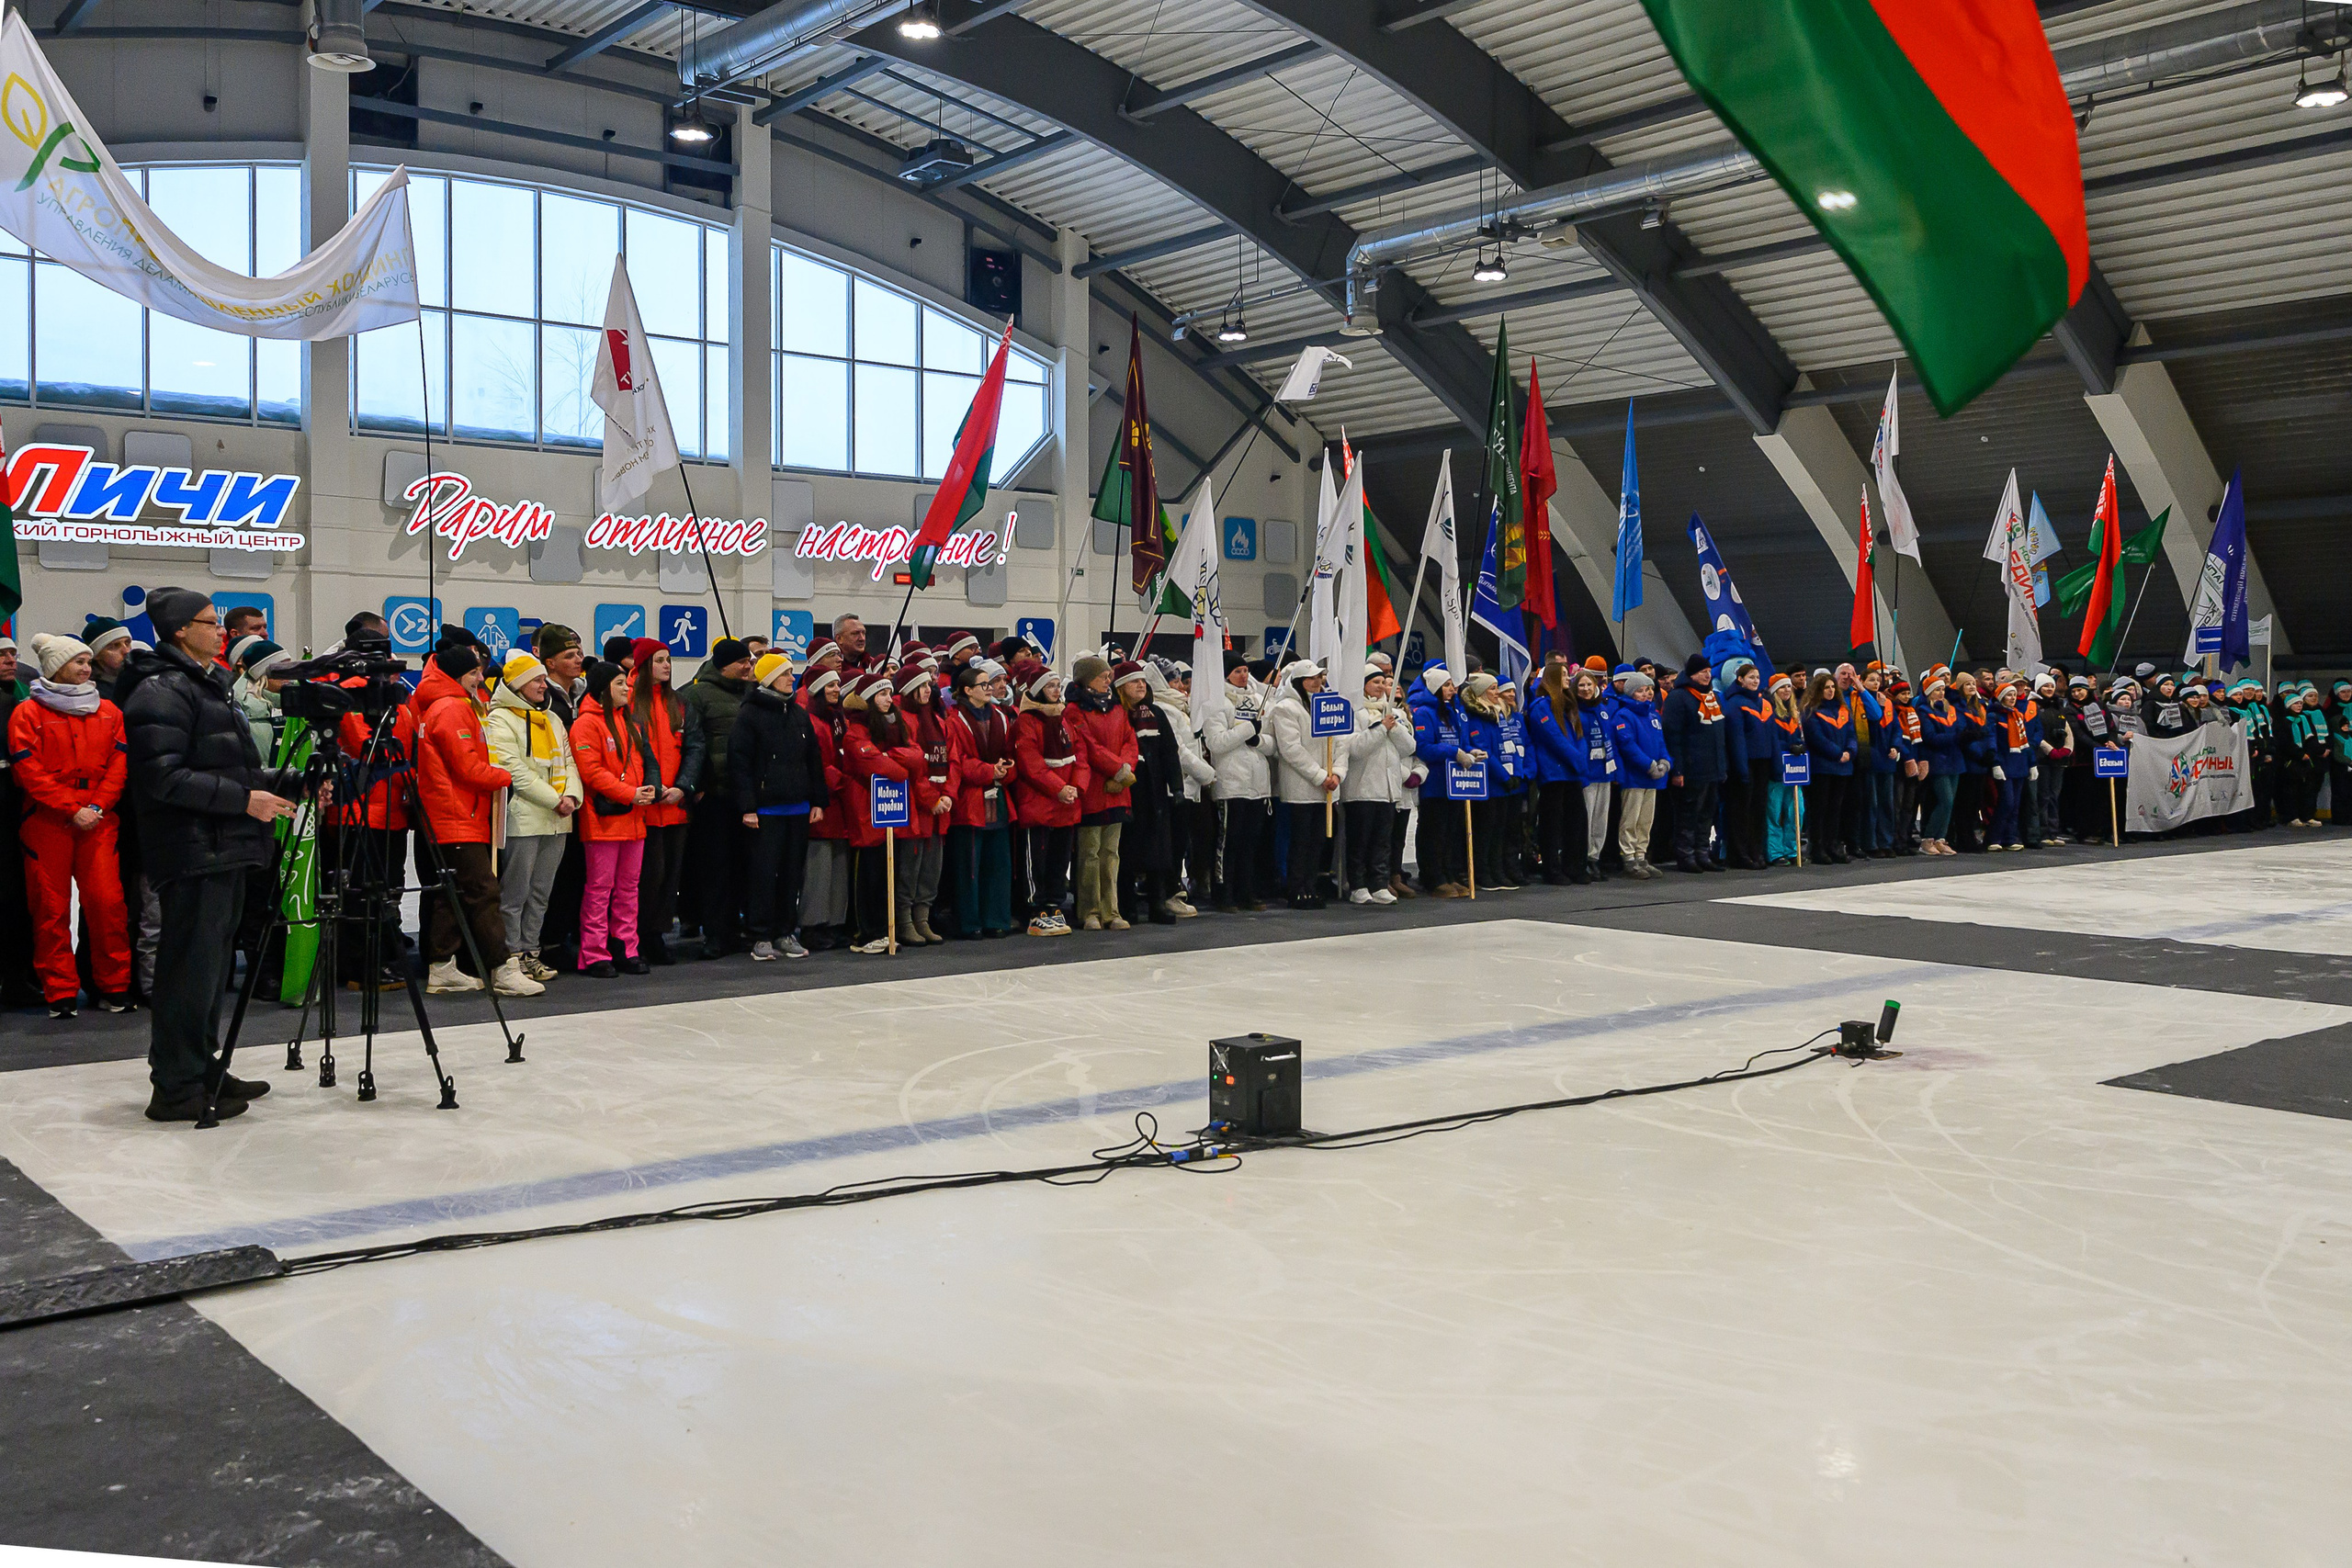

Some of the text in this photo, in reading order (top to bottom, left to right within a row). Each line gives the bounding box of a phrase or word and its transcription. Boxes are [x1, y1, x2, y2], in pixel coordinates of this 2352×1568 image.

[37, 192, 133, 260] УПРАВЛЕНИЯ
[407, 474, 553, 558] Дарим
[587, 513, 766, 555] отличное
[63, 526, 232, 545] ГОРНОЛЫЖНЫЙ
[239, 535, 301, 548] ЦЕНТР
[1320, 701, 1344, 713] Белые
[1319, 715, 1345, 728] тигры
